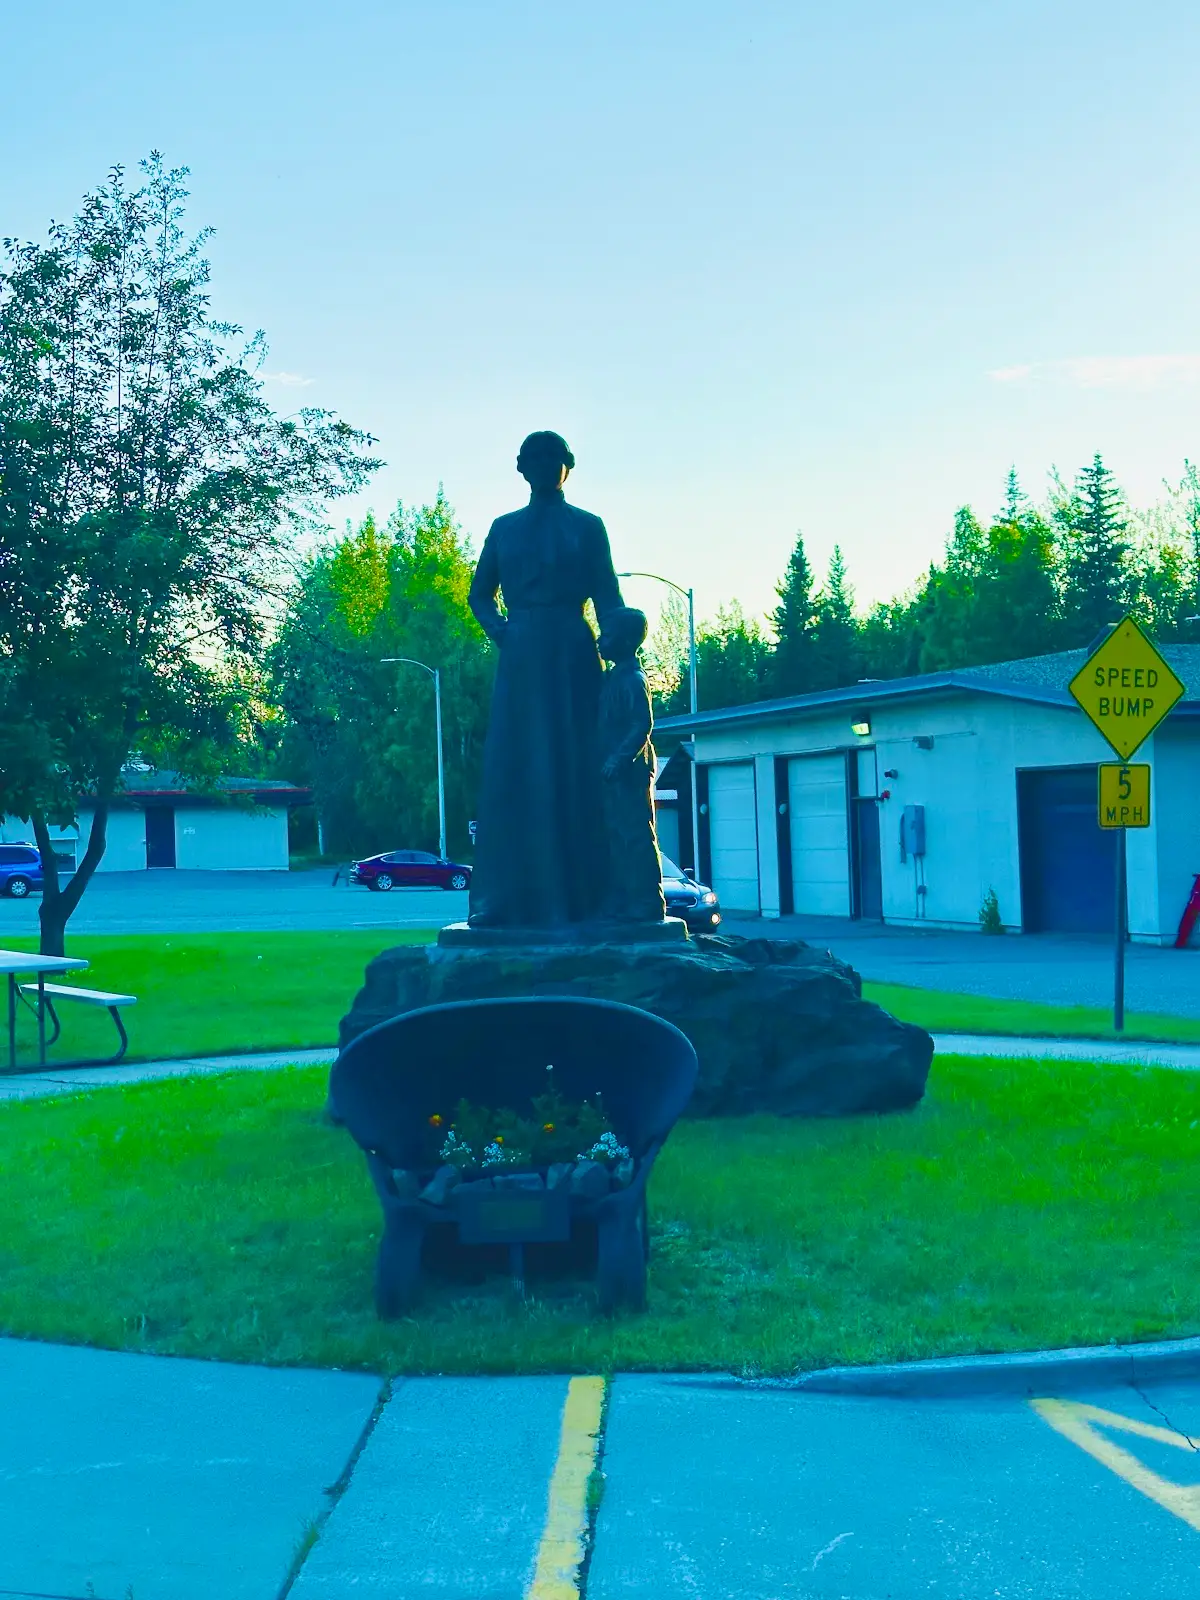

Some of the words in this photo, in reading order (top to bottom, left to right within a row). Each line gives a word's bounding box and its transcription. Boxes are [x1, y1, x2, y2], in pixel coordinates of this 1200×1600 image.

[1094, 666, 1159, 688] SPEED
[1099, 696, 1154, 718] BUMP
[1118, 769, 1132, 800] 5
